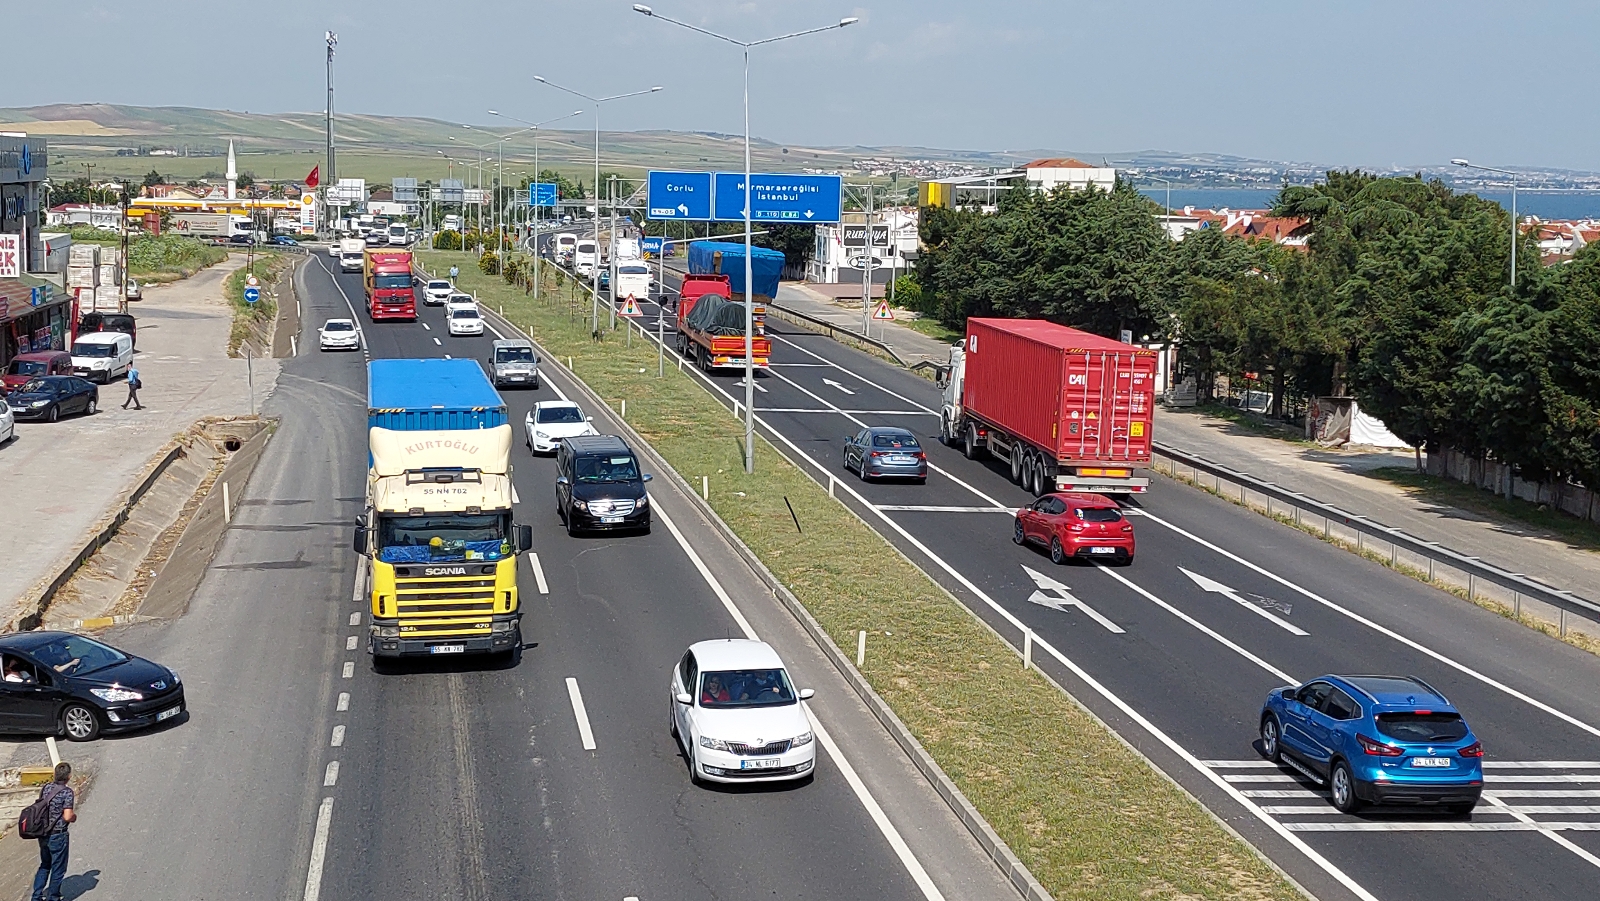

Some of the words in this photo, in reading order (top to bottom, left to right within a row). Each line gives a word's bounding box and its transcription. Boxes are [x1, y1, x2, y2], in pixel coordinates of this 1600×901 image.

[737, 183, 819, 194] Mrmaraereğlisi
[405, 439, 479, 455] KURTOĞLU
[425, 567, 466, 576] SCANIA
